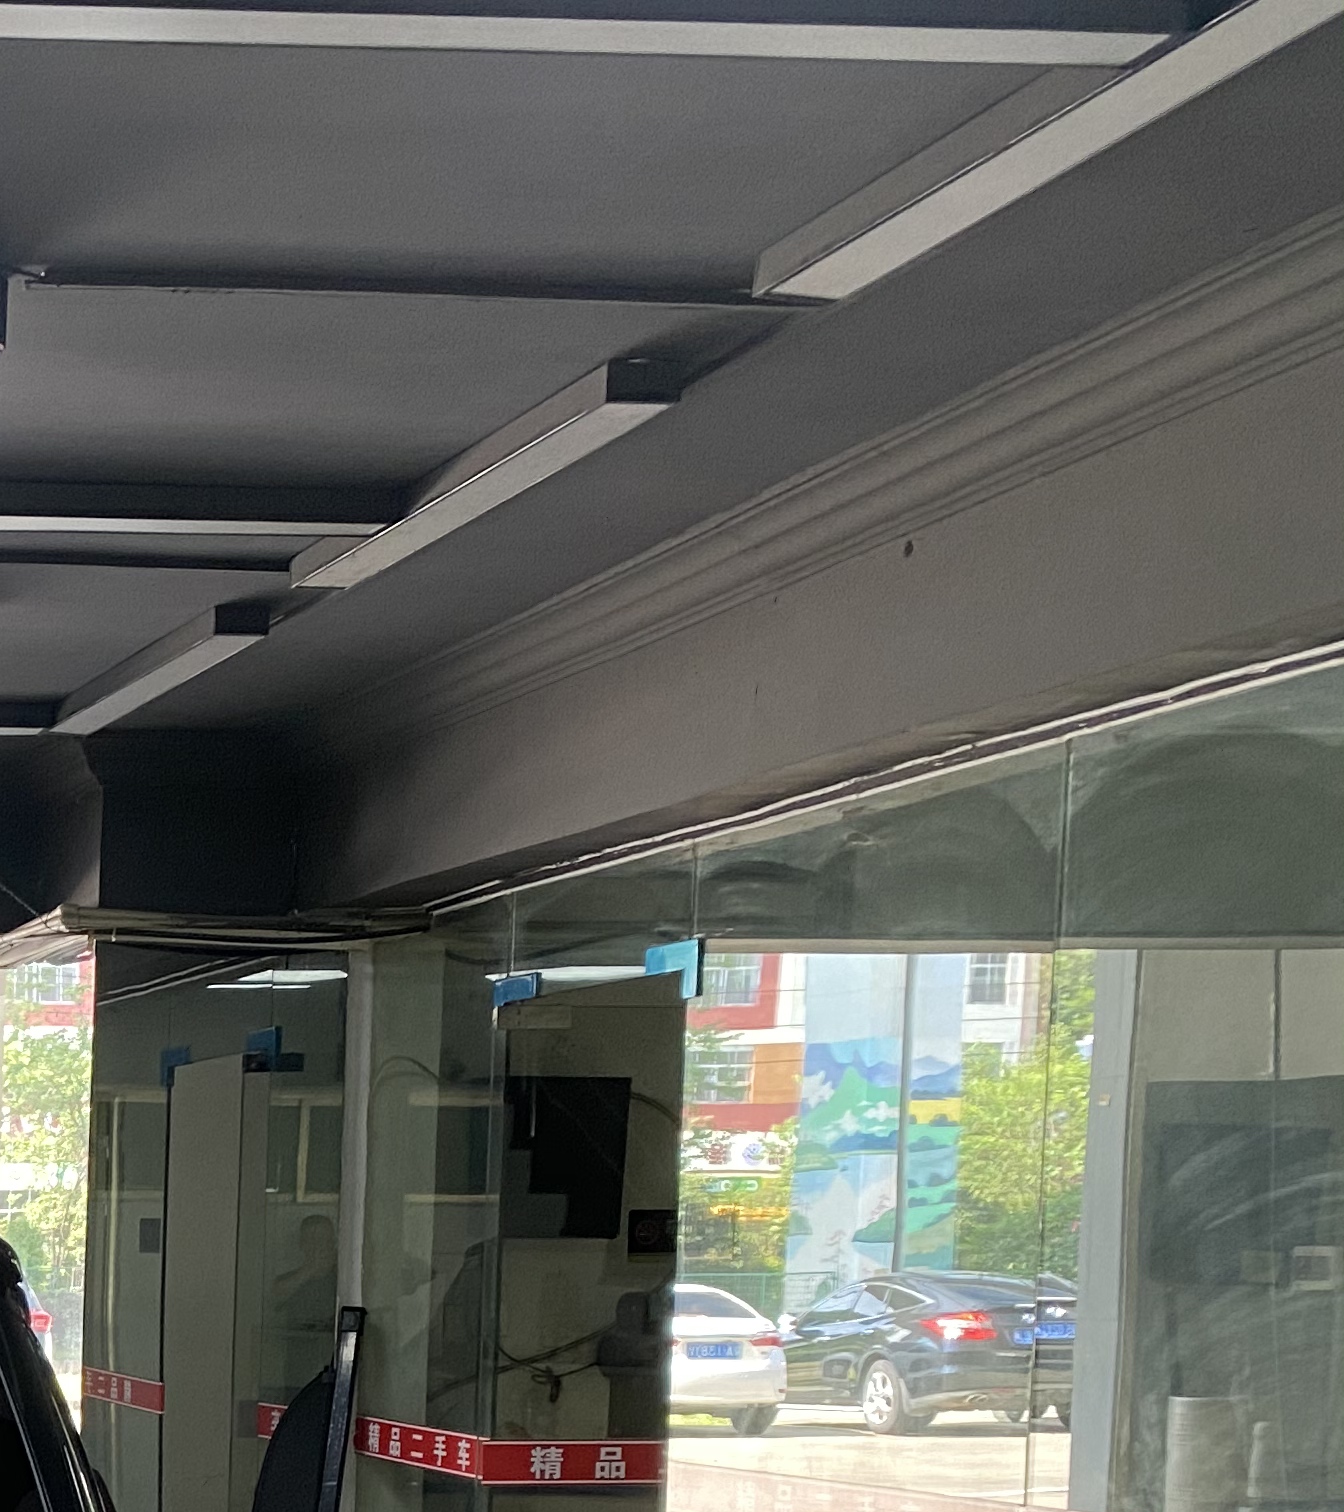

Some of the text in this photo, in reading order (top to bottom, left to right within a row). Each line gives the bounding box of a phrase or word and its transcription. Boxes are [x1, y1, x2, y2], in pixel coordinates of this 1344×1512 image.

[368, 1422, 471, 1471] 精品二手车
[530, 1446, 626, 1479] 精品
